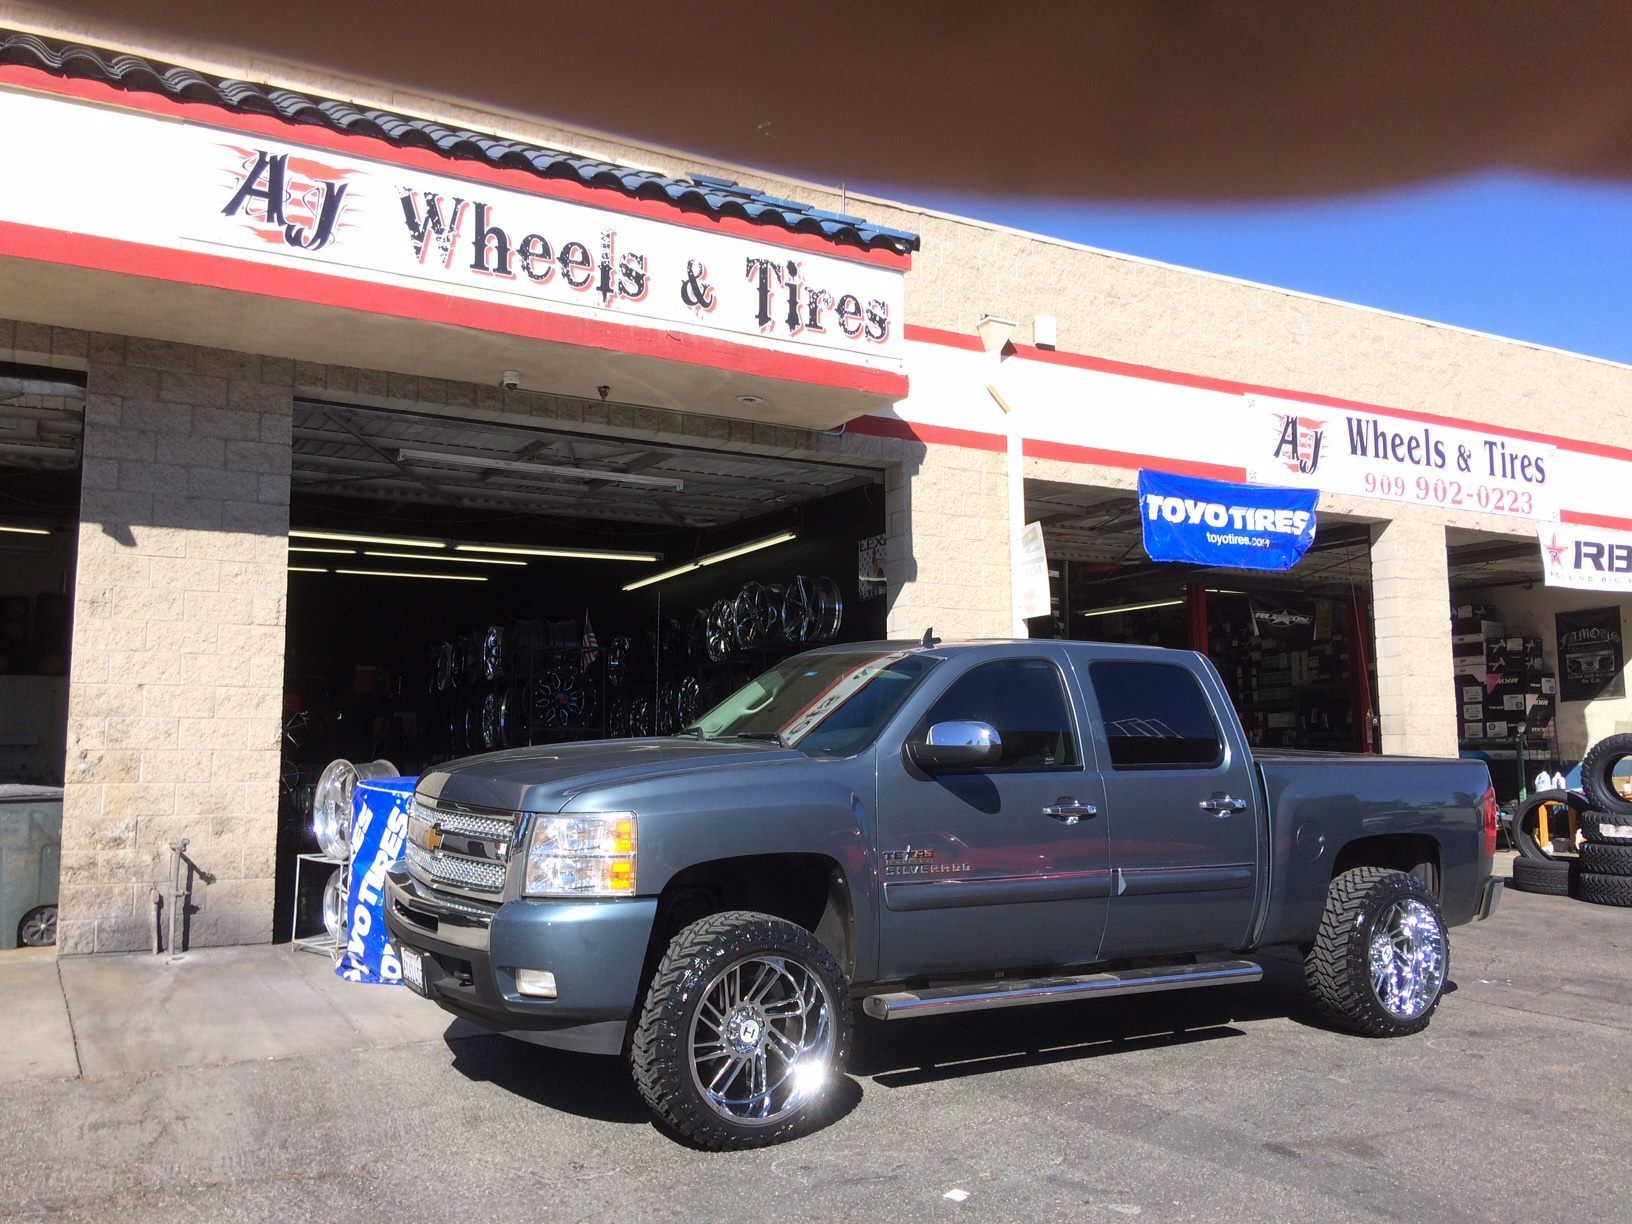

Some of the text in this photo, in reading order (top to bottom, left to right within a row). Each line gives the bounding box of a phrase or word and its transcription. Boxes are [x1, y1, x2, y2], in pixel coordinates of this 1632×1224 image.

[221, 149, 891, 344] AJ Wheels & Tires
[1273, 415, 1546, 485] AJ Wheels & Tires
[1364, 472, 1533, 515] 909 902-0223
